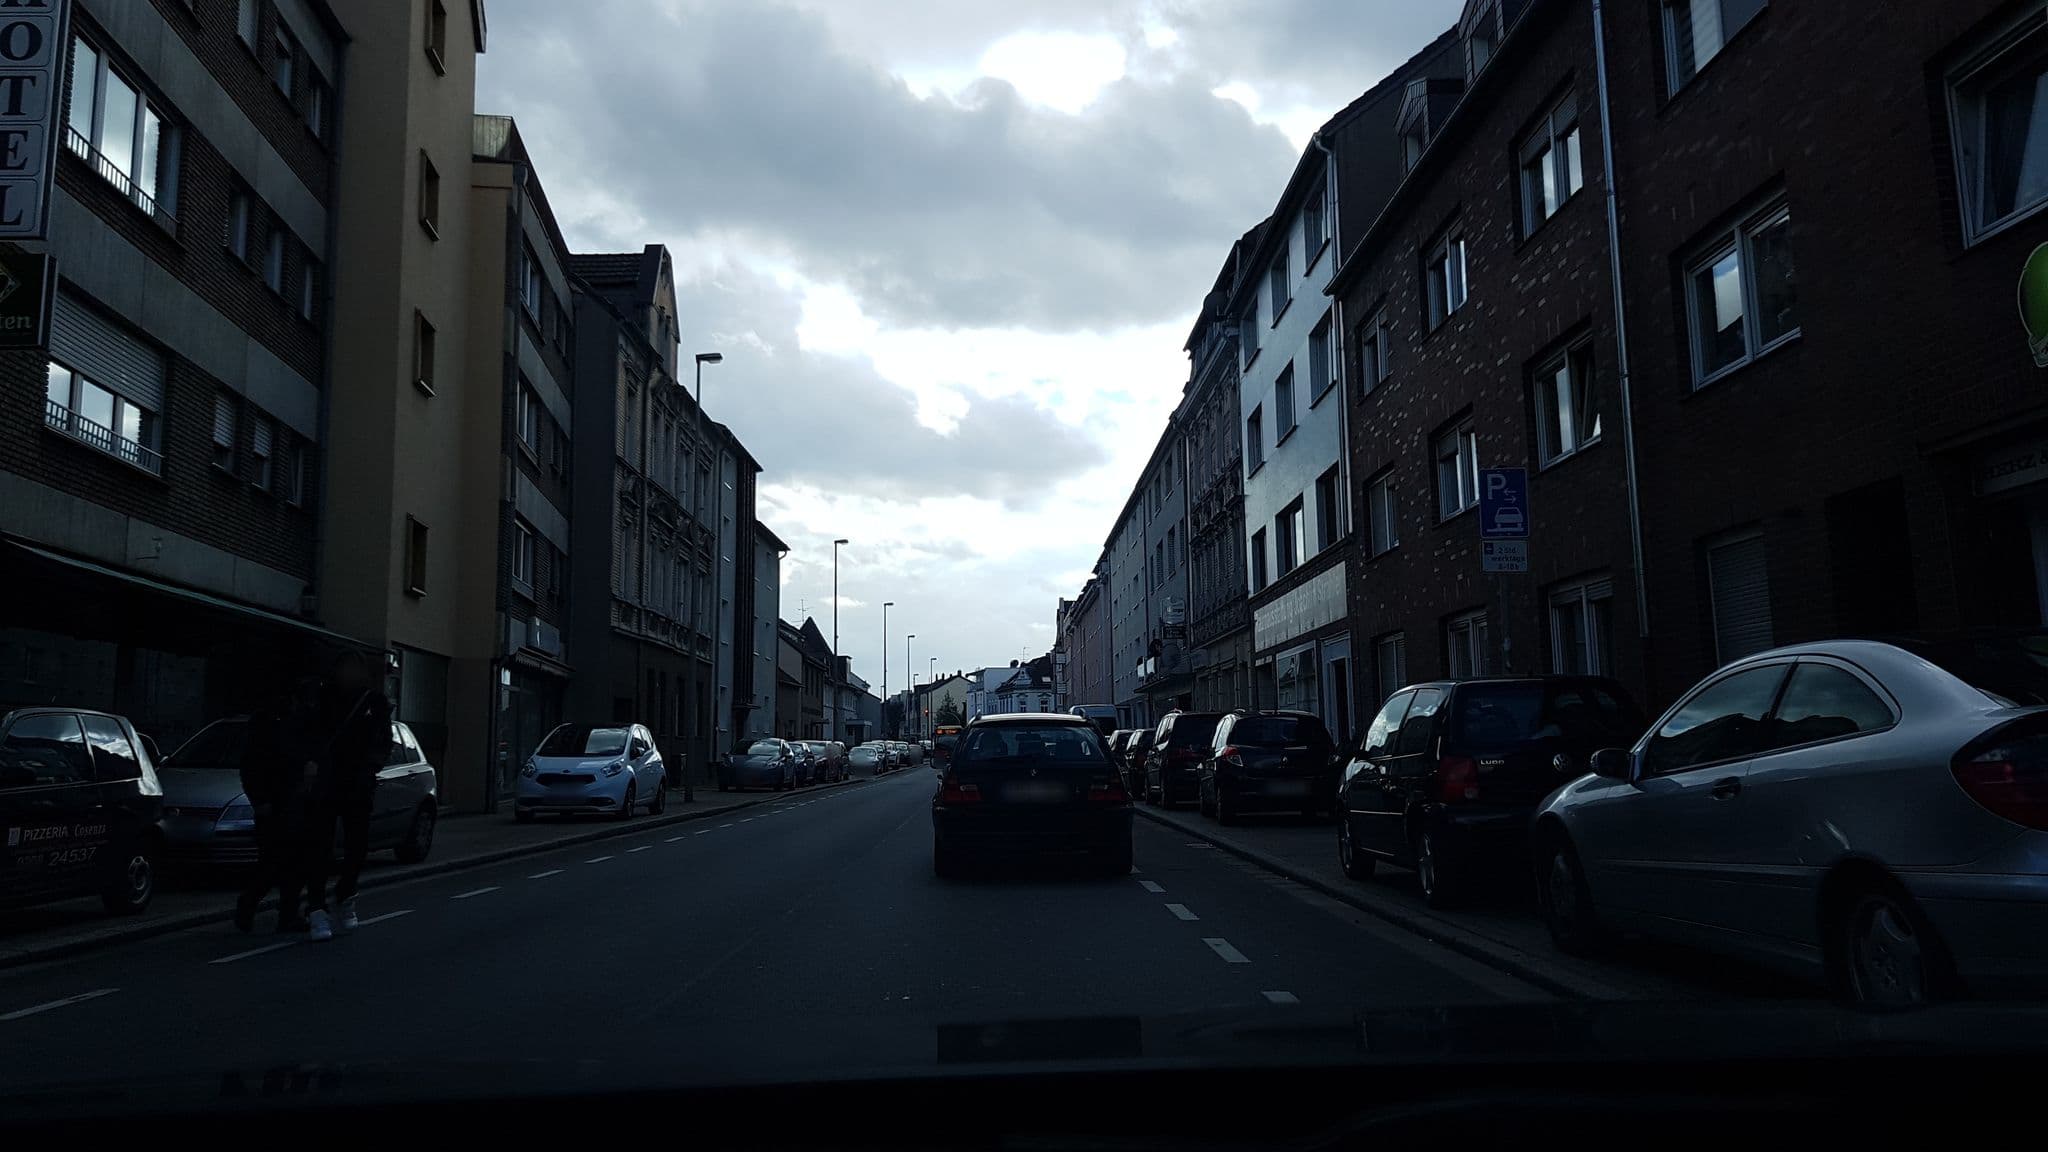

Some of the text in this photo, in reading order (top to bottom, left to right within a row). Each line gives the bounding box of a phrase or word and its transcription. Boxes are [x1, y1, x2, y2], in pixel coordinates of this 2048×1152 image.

[0, 0, 47, 226] OTEL
[1487, 474, 1506, 500] P
[23, 825, 69, 841] PIZZERIA
[48, 847, 96, 866] 24537
